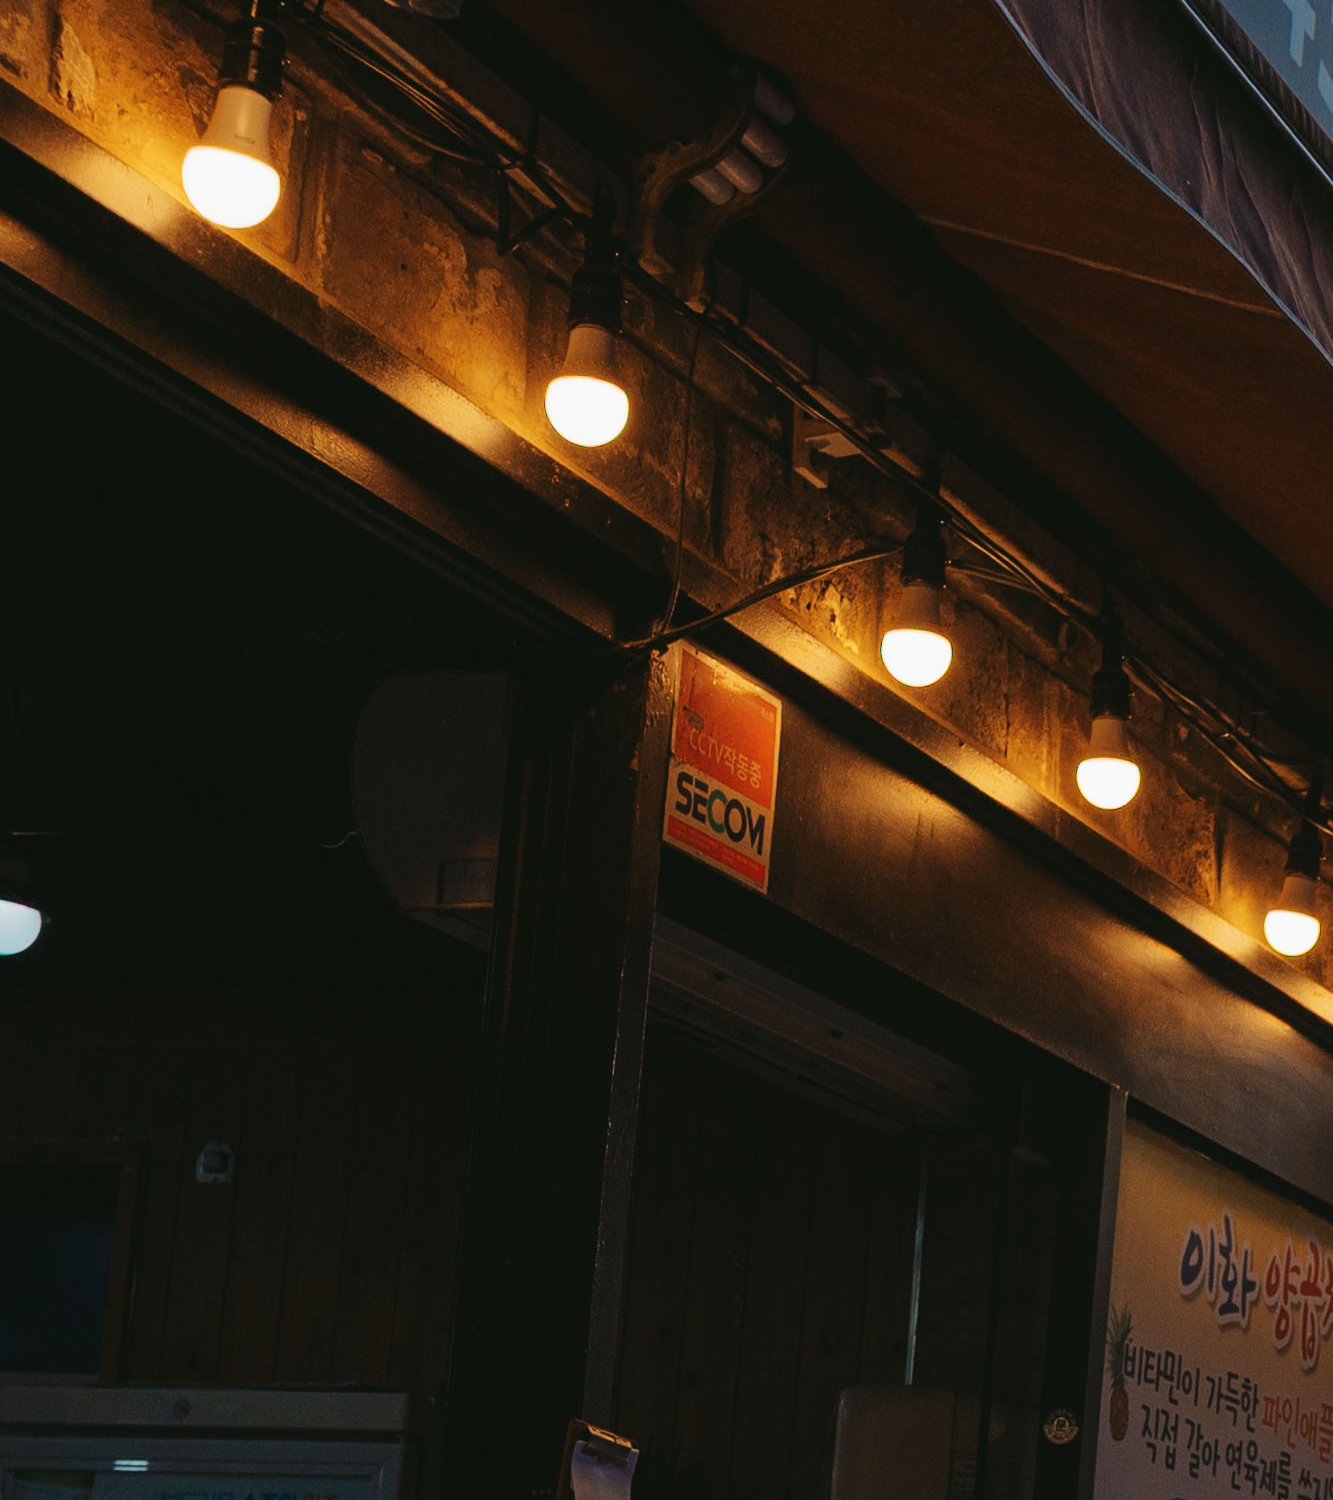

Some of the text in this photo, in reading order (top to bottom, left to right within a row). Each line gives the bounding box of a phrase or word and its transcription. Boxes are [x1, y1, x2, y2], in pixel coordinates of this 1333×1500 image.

[689, 728, 762, 789] CCTV작동중
[675, 771, 766, 856] SECOM
[1181, 1211, 1258, 1322] 이화
[1123, 1342, 1199, 1406] 비타민이
[1206, 1371, 1259, 1433] 가득한
[1141, 1403, 1179, 1471] 직접
